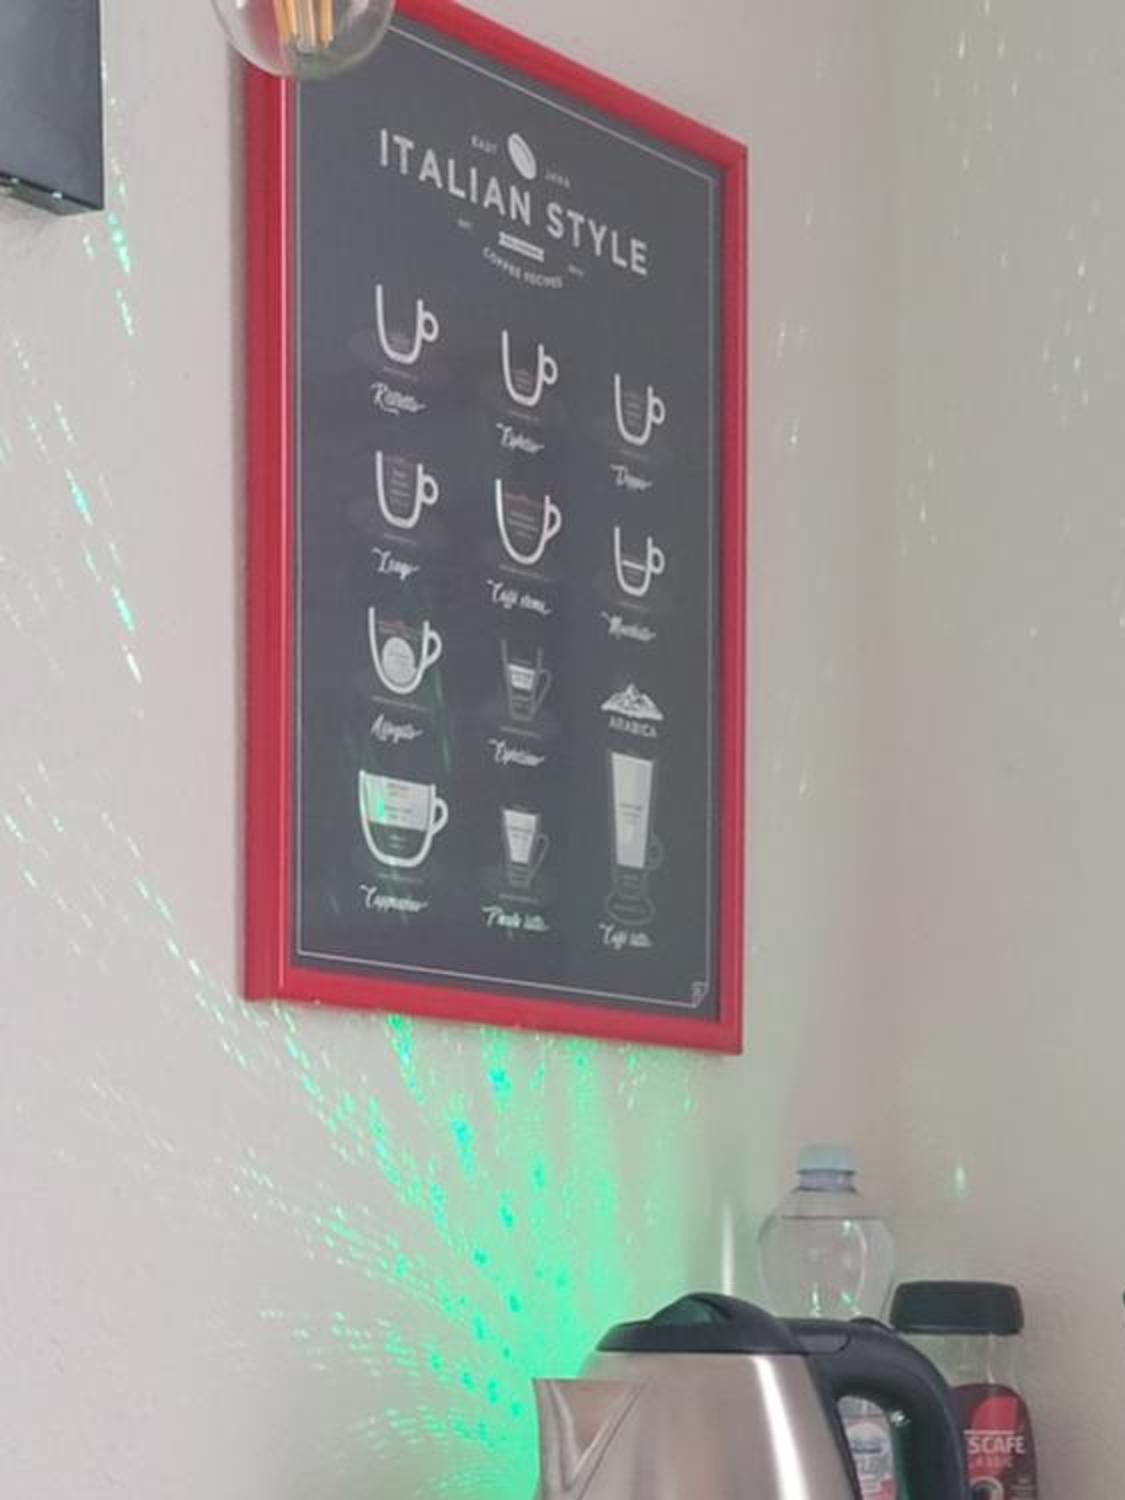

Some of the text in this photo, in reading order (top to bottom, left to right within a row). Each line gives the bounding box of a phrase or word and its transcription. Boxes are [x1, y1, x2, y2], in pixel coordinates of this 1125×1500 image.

[380, 127, 648, 276] ITALIAN STYLE
[483, 246, 522, 279] COFFEE
[965, 1433, 1026, 1456] SCAFE
